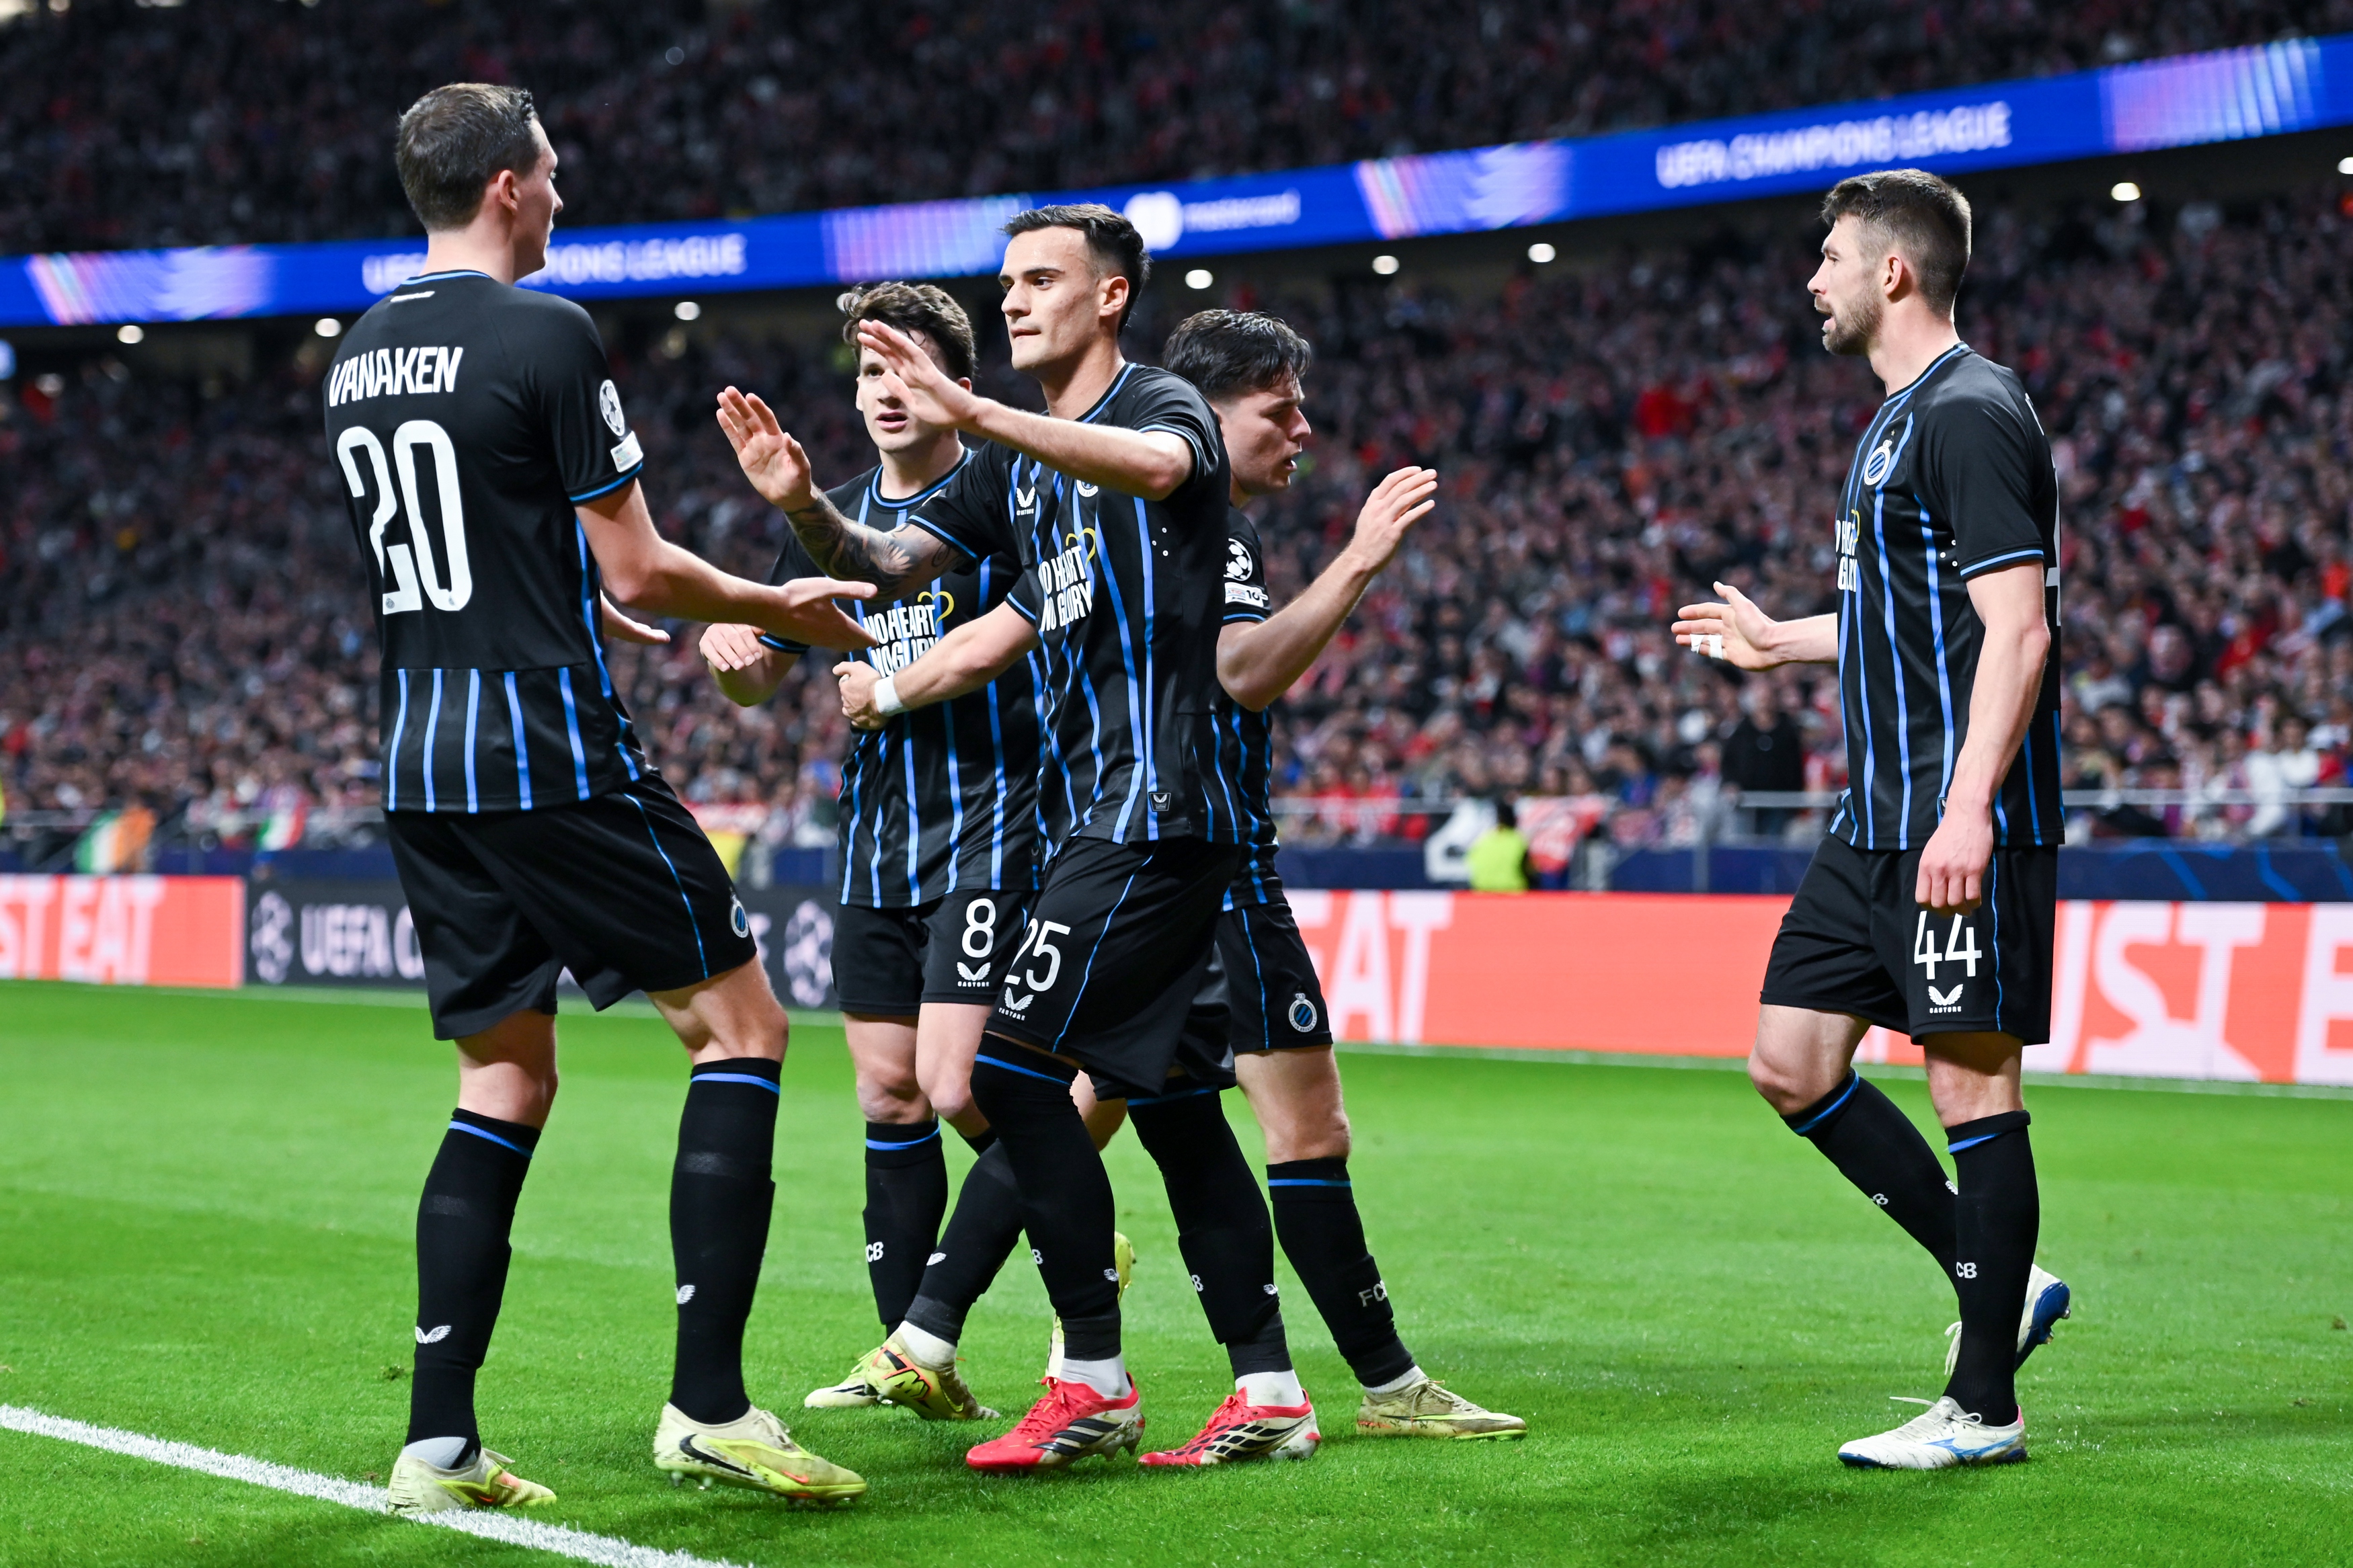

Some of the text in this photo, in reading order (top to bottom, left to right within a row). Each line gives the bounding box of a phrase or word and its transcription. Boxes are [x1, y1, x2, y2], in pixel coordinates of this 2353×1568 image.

[1656, 100, 2012, 188] UEFA CHAMPIONS LEAGUE
[329, 346, 463, 407] VANAKEN
[336, 419, 473, 616] 20
[886, 604, 936, 641] HEART
[59, 876, 167, 987] EAT
[301, 903, 393, 978] UEFA
[961, 898, 996, 958] 8
[1004, 918, 1071, 992] 25
[1914, 911, 1983, 980] 44
[1929, 1006, 1962, 1014] CASTORE
[865, 1241, 884, 1263] CB
[1956, 1262, 1978, 1279] CB
